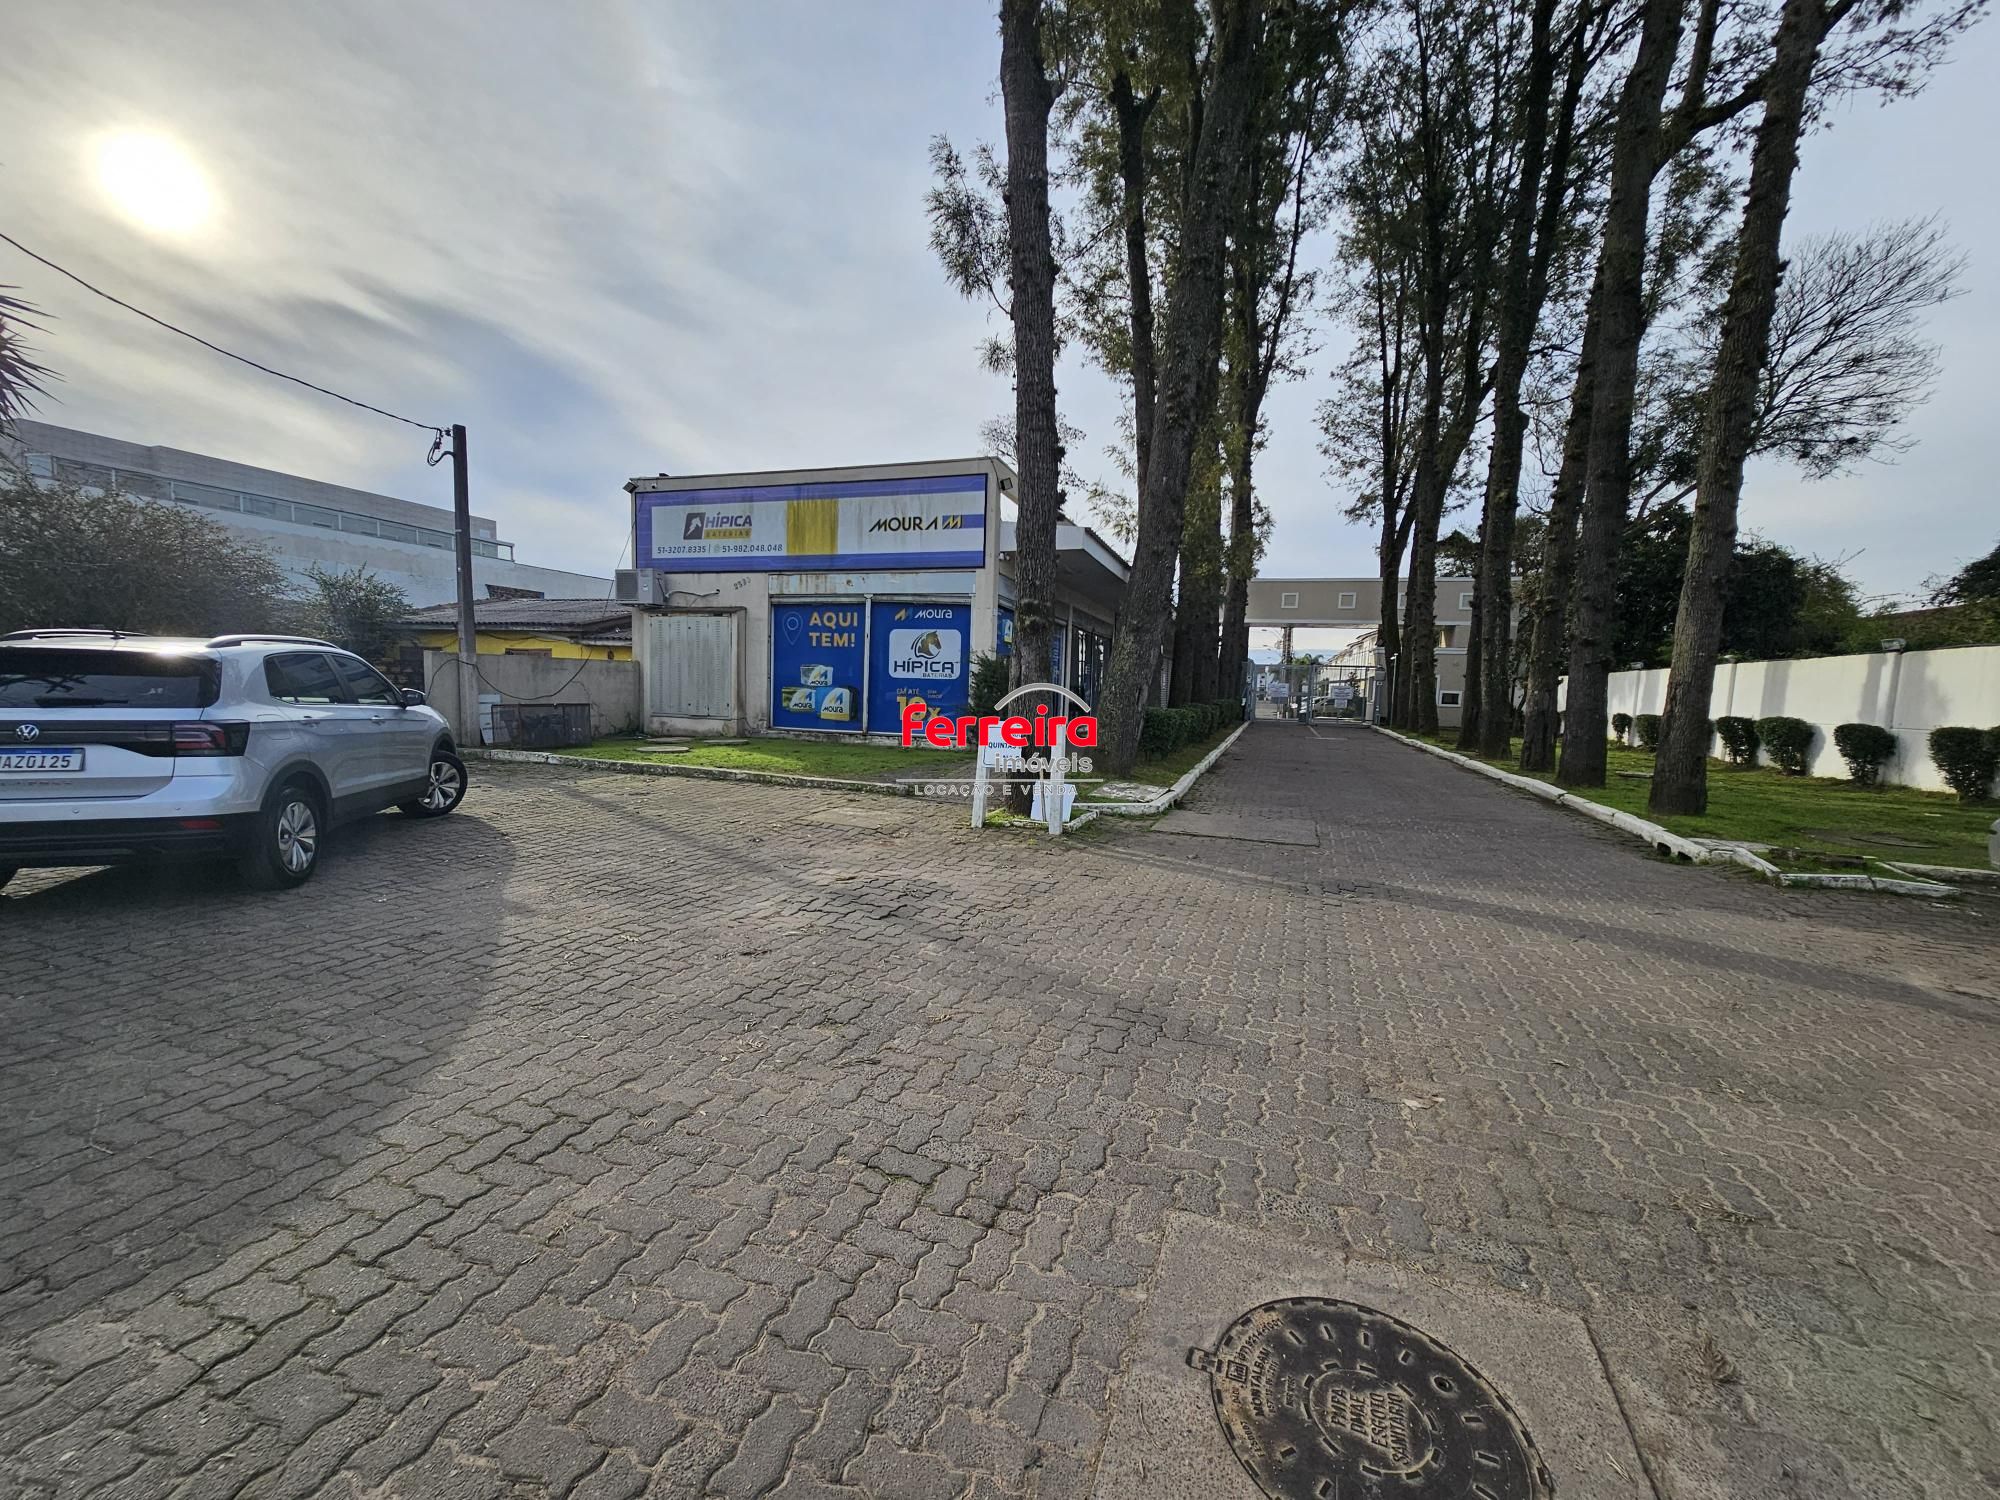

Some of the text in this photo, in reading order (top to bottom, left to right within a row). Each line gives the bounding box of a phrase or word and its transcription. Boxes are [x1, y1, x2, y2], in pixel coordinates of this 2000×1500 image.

[705, 512, 752, 528] HÍPICA
[869, 516, 938, 532] MOURA
[809, 611, 858, 629] AQUI
[809, 632, 856, 648] TEM!
[894, 658, 955, 675] HÍPICA
[1349, 1391, 1369, 1437] DMAE
[1369, 1392, 1388, 1448] ESGOTO
